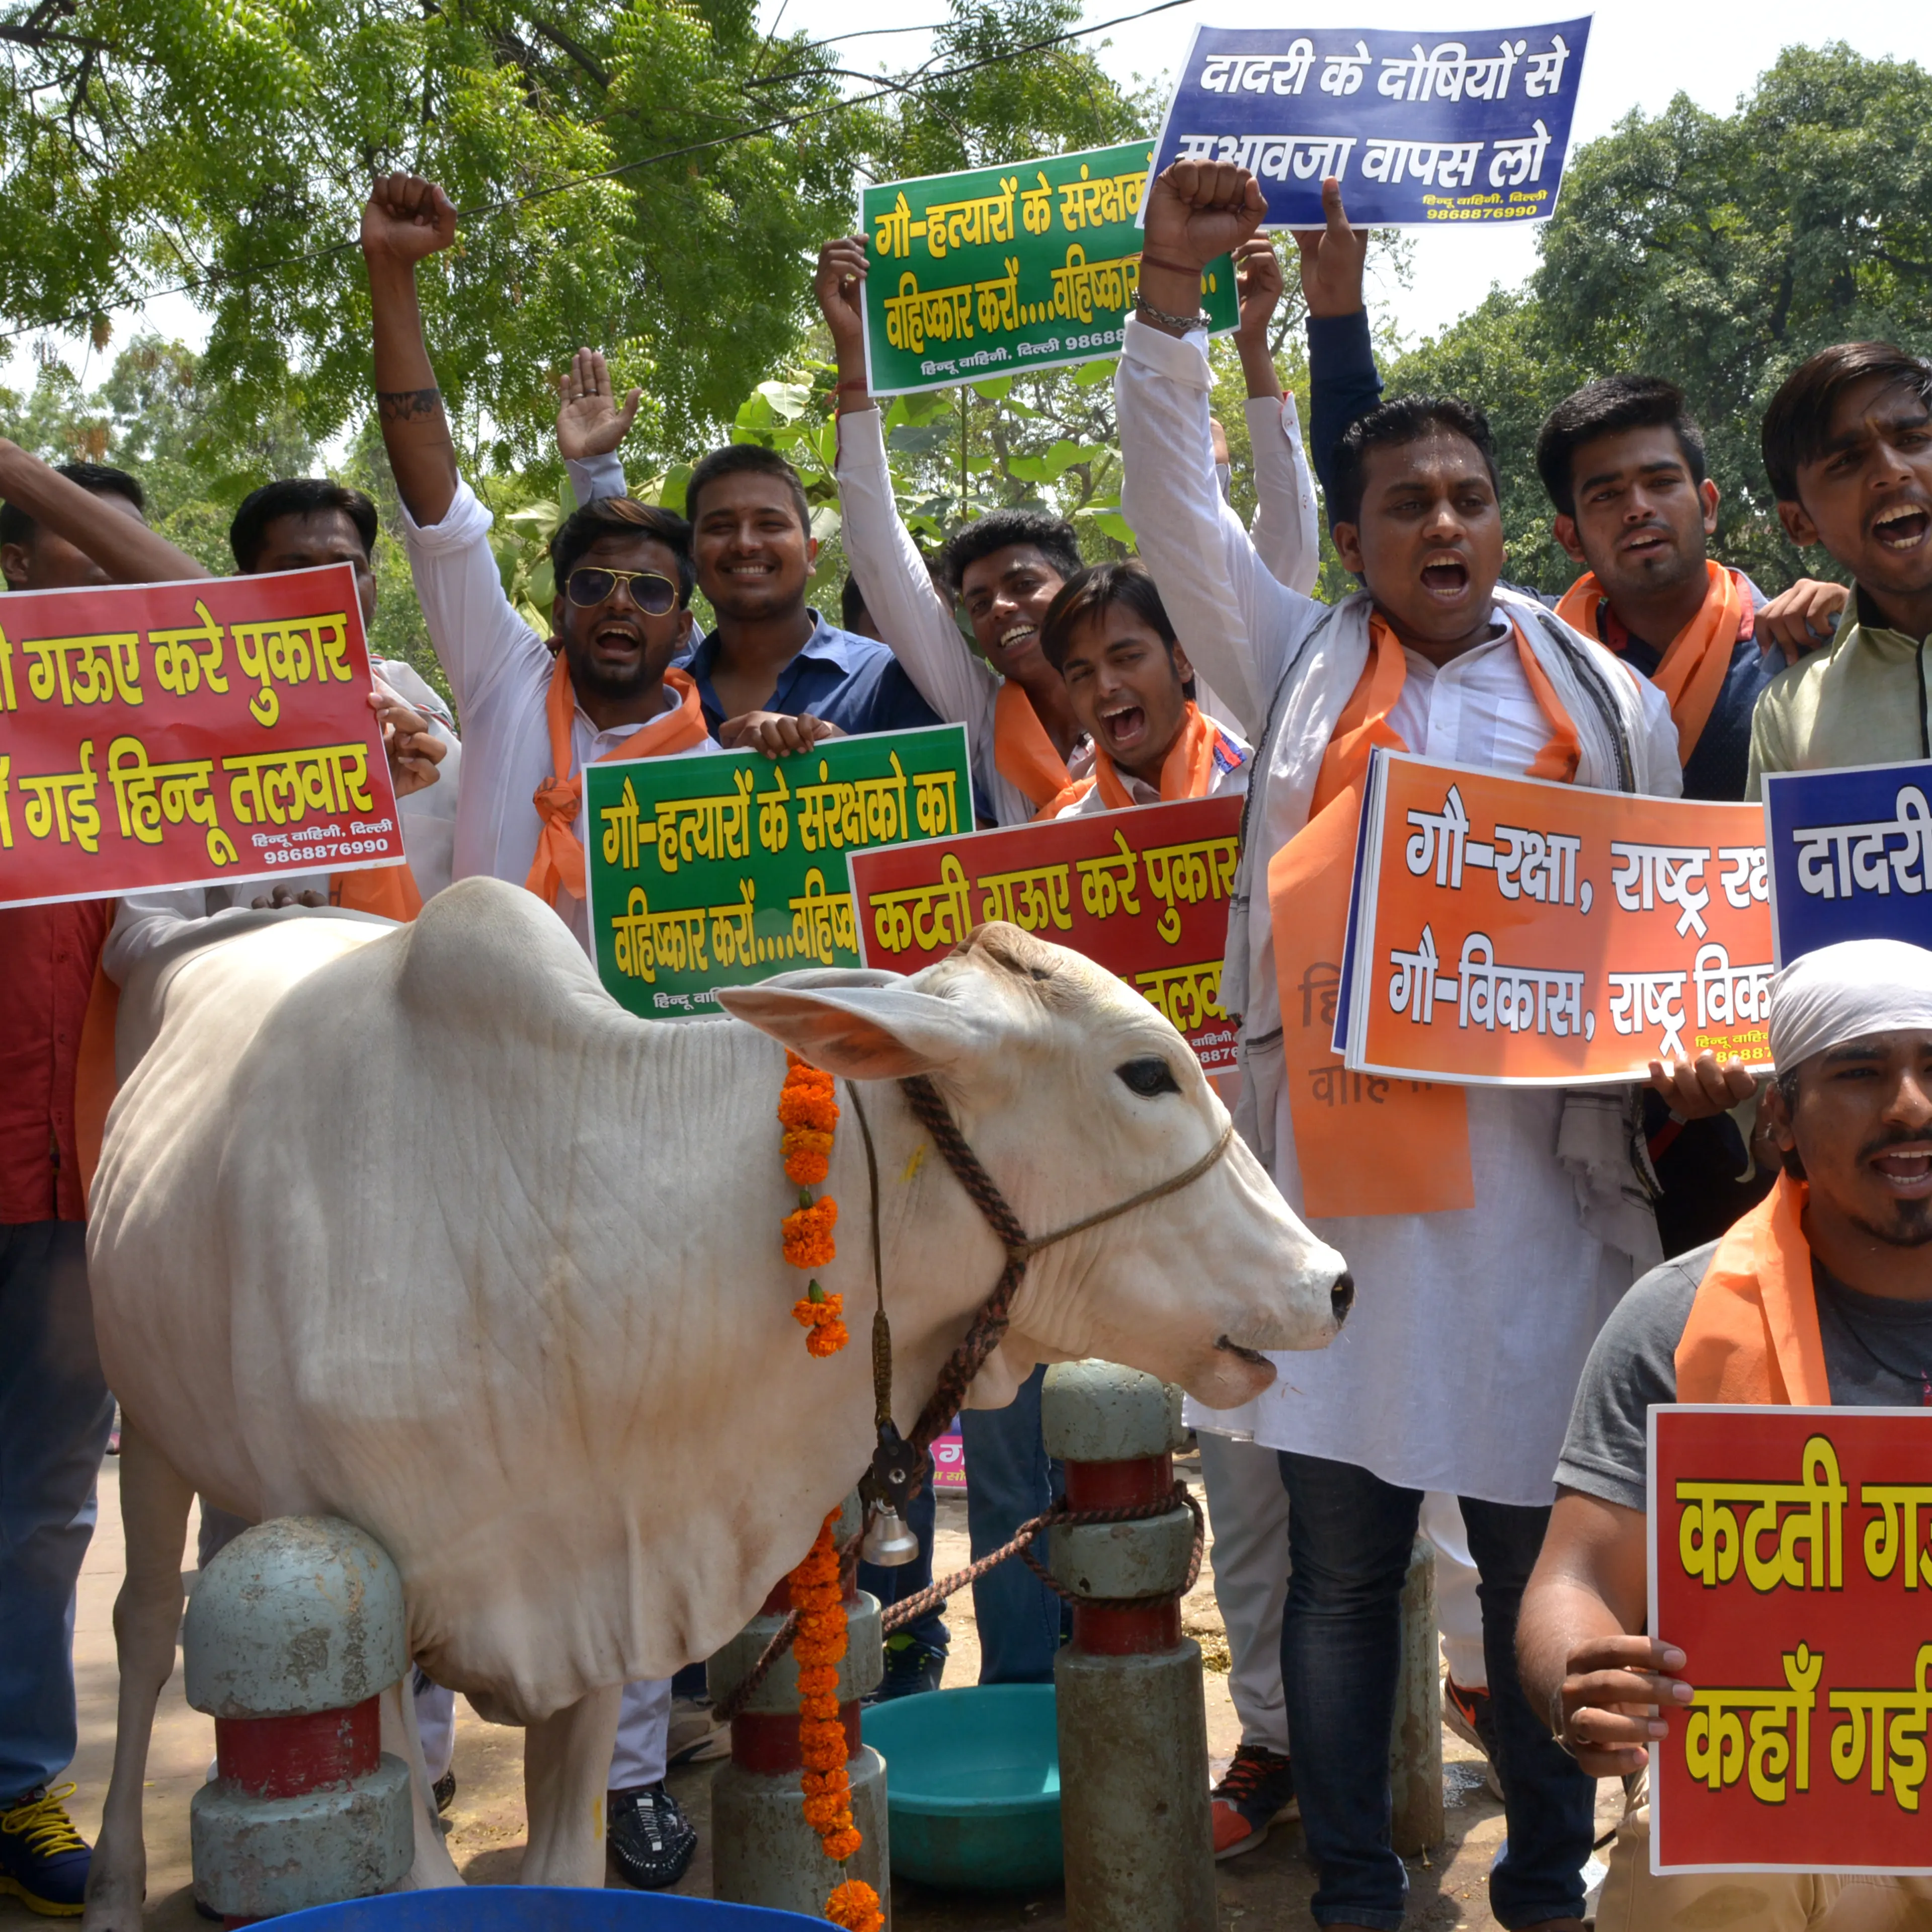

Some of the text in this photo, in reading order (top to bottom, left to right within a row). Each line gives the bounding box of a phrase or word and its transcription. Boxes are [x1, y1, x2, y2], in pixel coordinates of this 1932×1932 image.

[1200, 34, 1570, 102] दादरी के दोषियों से
[1360, 138, 1484, 188] वापस
[1488, 119, 1553, 188] लो
[874, 175, 1018, 259] गौ-हत्यारों
[1021, 170, 1052, 235] के
[1422, 194, 1455, 209] हिन्दू
[1509, 189, 1548, 203] दिल्ली
[1426, 205, 1537, 219] 9868876990
[921, 360, 959, 375] हिन्दू
[1017, 338, 1060, 357] दिल्ली
[1065, 329, 1124, 350] 98688
[22, 631, 143, 707] गऊए
[148, 597, 229, 696] करे
[230, 611, 354, 727] पुकार
[19, 740, 101, 853] गई
[107, 735, 240, 867] हिन्दू
[222, 742, 374, 826] तलवार
[252, 833, 293, 847] हिन्दू
[350, 818, 392, 836] दिल्ली
[601, 768, 755, 873] गौ-हत्यारों
[757, 765, 790, 854] के
[796, 749, 909, 853] संरक्षको
[913, 770, 958, 837] का
[264, 839, 388, 864] 9868876990
[1406, 783, 1593, 914] गौ-रक्षा,
[1611, 840, 1711, 940] राष्ट्र
[1792, 783, 1932, 900] दादरी
[868, 829, 1239, 953] कटती गऊए करे पुकार
[653, 992, 694, 1010] हिन्दू
[1135, 959, 1228, 1032] तलव
[1389, 923, 1775, 1057] गौ-विकास, राष्ट्र विक
[1191, 1030, 1232, 1046] वाहिनी
[1695, 1035, 1732, 1049] हिन्दू
[1675, 1433, 1848, 1594] कटती
[1686, 1640, 1932, 1813] कहाँ गई
